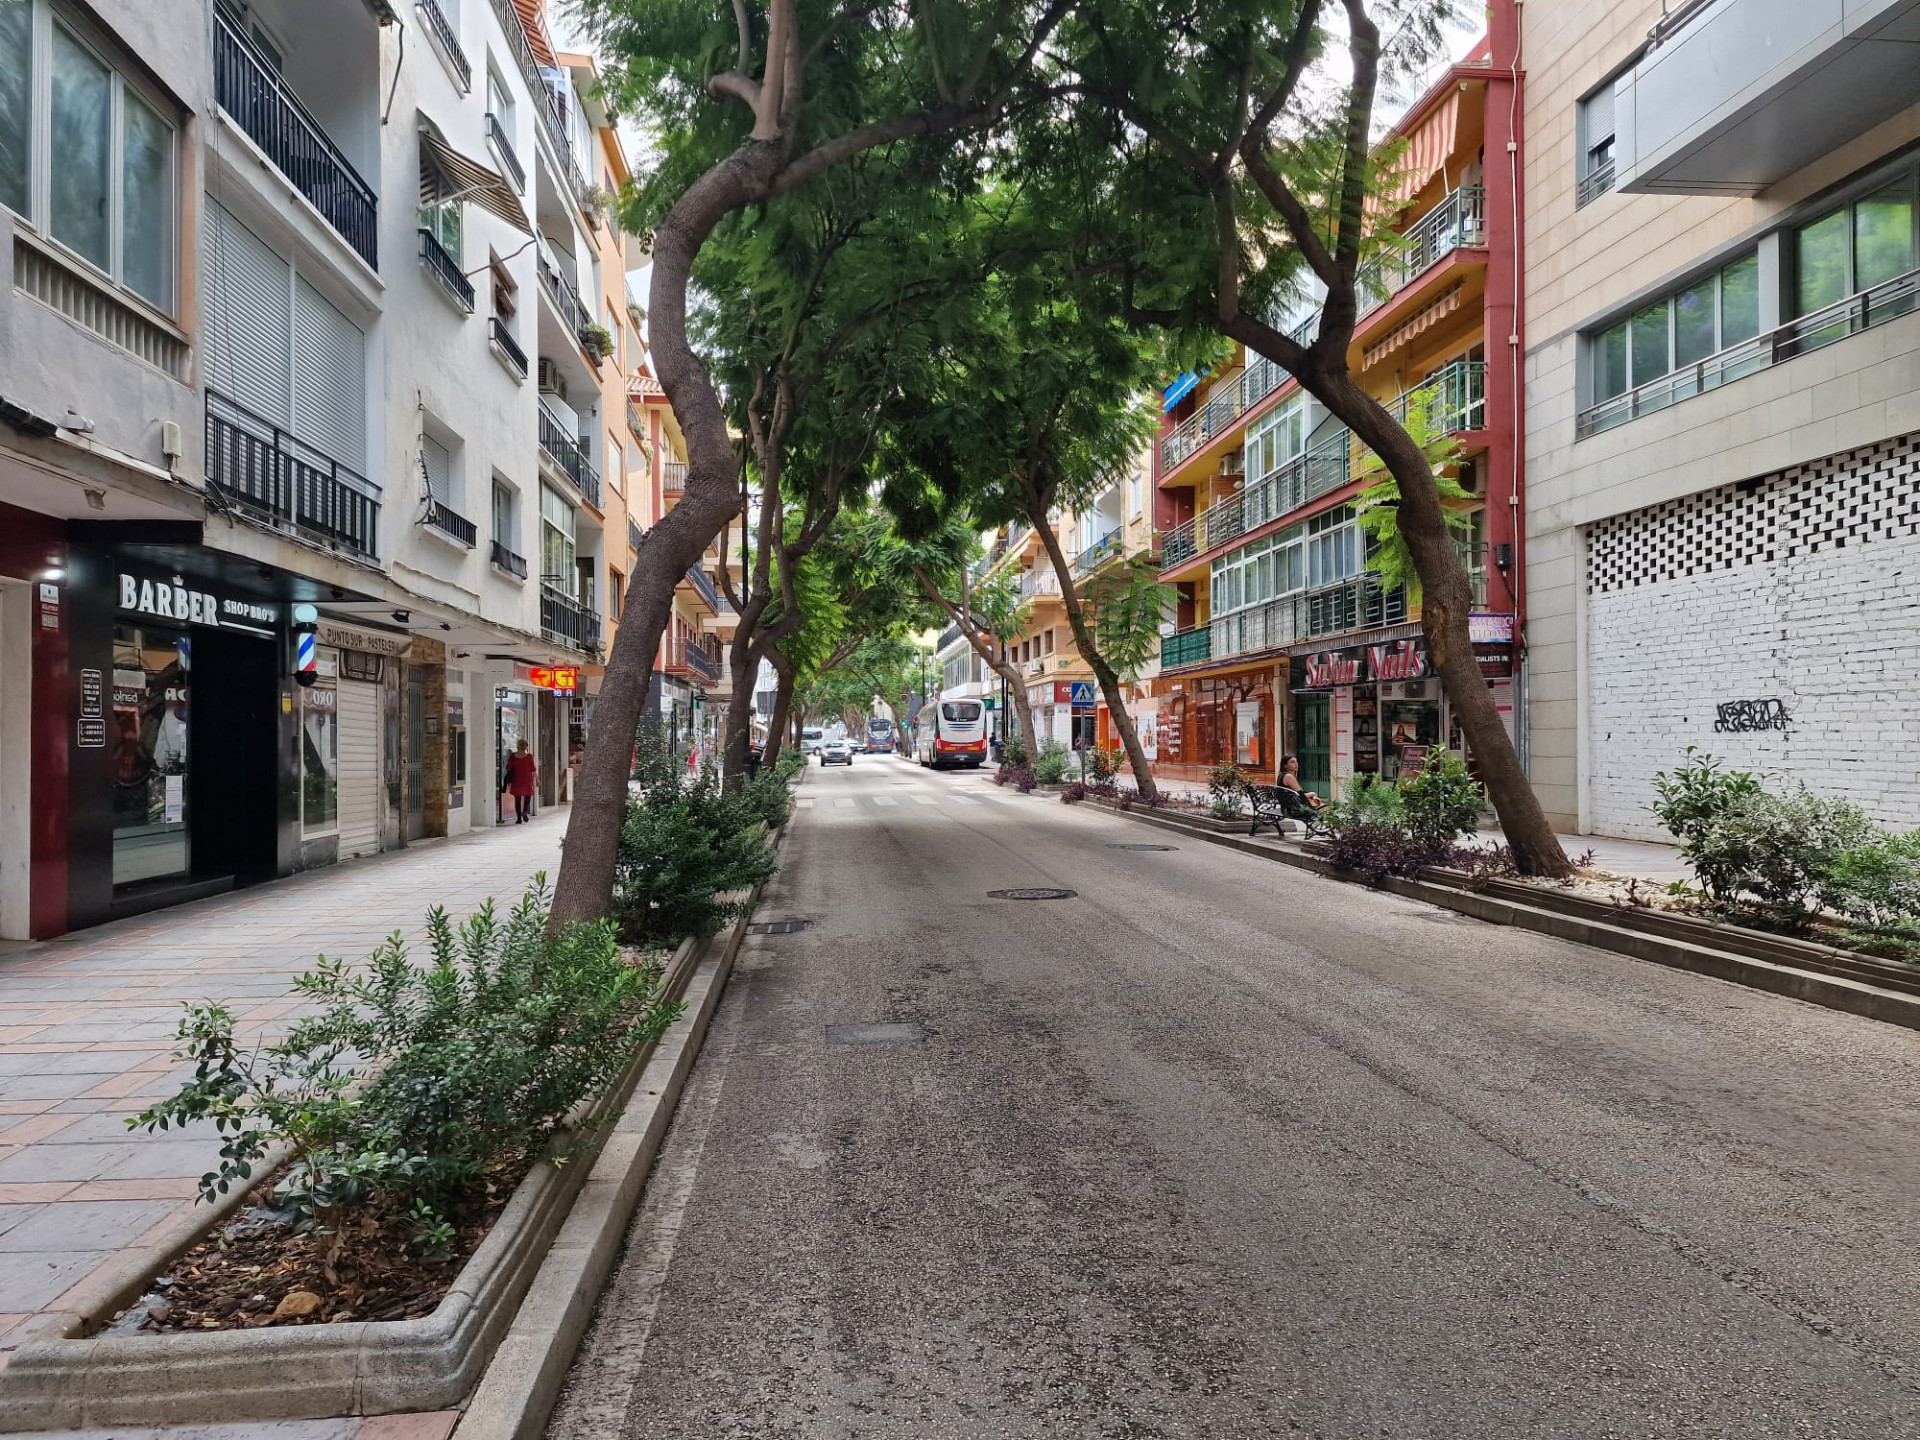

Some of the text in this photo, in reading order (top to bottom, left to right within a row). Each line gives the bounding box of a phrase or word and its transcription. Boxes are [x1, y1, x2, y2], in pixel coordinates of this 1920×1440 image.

[119, 574, 275, 626] BARBER SHOP BRO'S
[1366, 641, 1426, 681] Nails
[1475, 655, 1501, 663] CIALISTS
